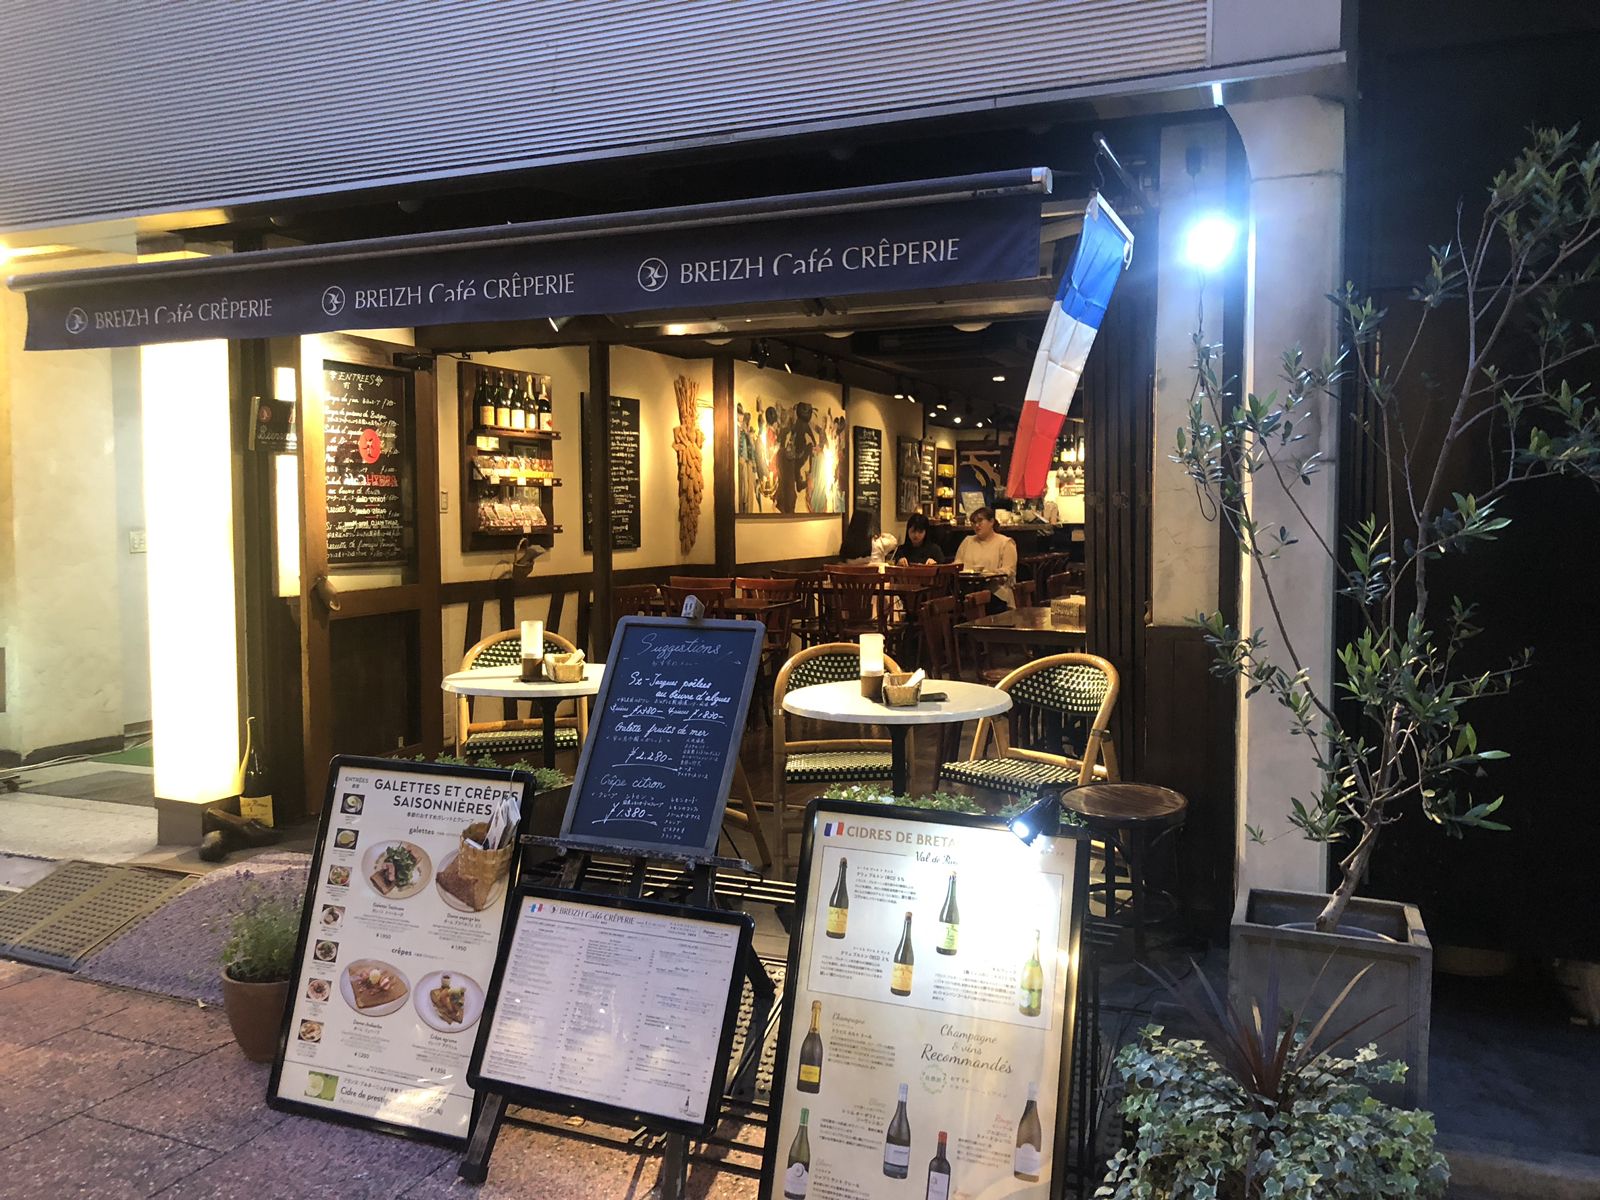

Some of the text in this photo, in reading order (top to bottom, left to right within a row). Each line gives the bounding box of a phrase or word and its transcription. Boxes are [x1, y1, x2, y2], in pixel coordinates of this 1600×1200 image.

[679, 238, 961, 284] BREIZH Café CRÊPERIE
[354, 271, 575, 309] BREIZH Café CRÊPERIE
[95, 297, 273, 329] BREIZH Café CRÊPERIE
[637, 633, 722, 659] Suggestions
[614, 722, 642, 733] Galette
[643, 723, 677, 739] fruits
[677, 724, 687, 735] de
[688, 728, 709, 738] mer
[374, 778, 520, 803] GALETTES ET CRÊPES
[600, 773, 666, 793] Crêpe citron
[393, 795, 493, 816] SAISONNIÈRES
[409, 826, 435, 836] galettes
[847, 825, 957, 848] CIDRES DE BRETA
[915, 851, 929, 862] Val
[391, 947, 412, 956] crêpes
[940, 1023, 998, 1044] Champagne
[921, 1043, 1013, 1074] Recommandés
[961, 1044, 982, 1055] vins
[340, 1086, 357, 1098] Cidre
[357, 1089, 367, 1099] de
